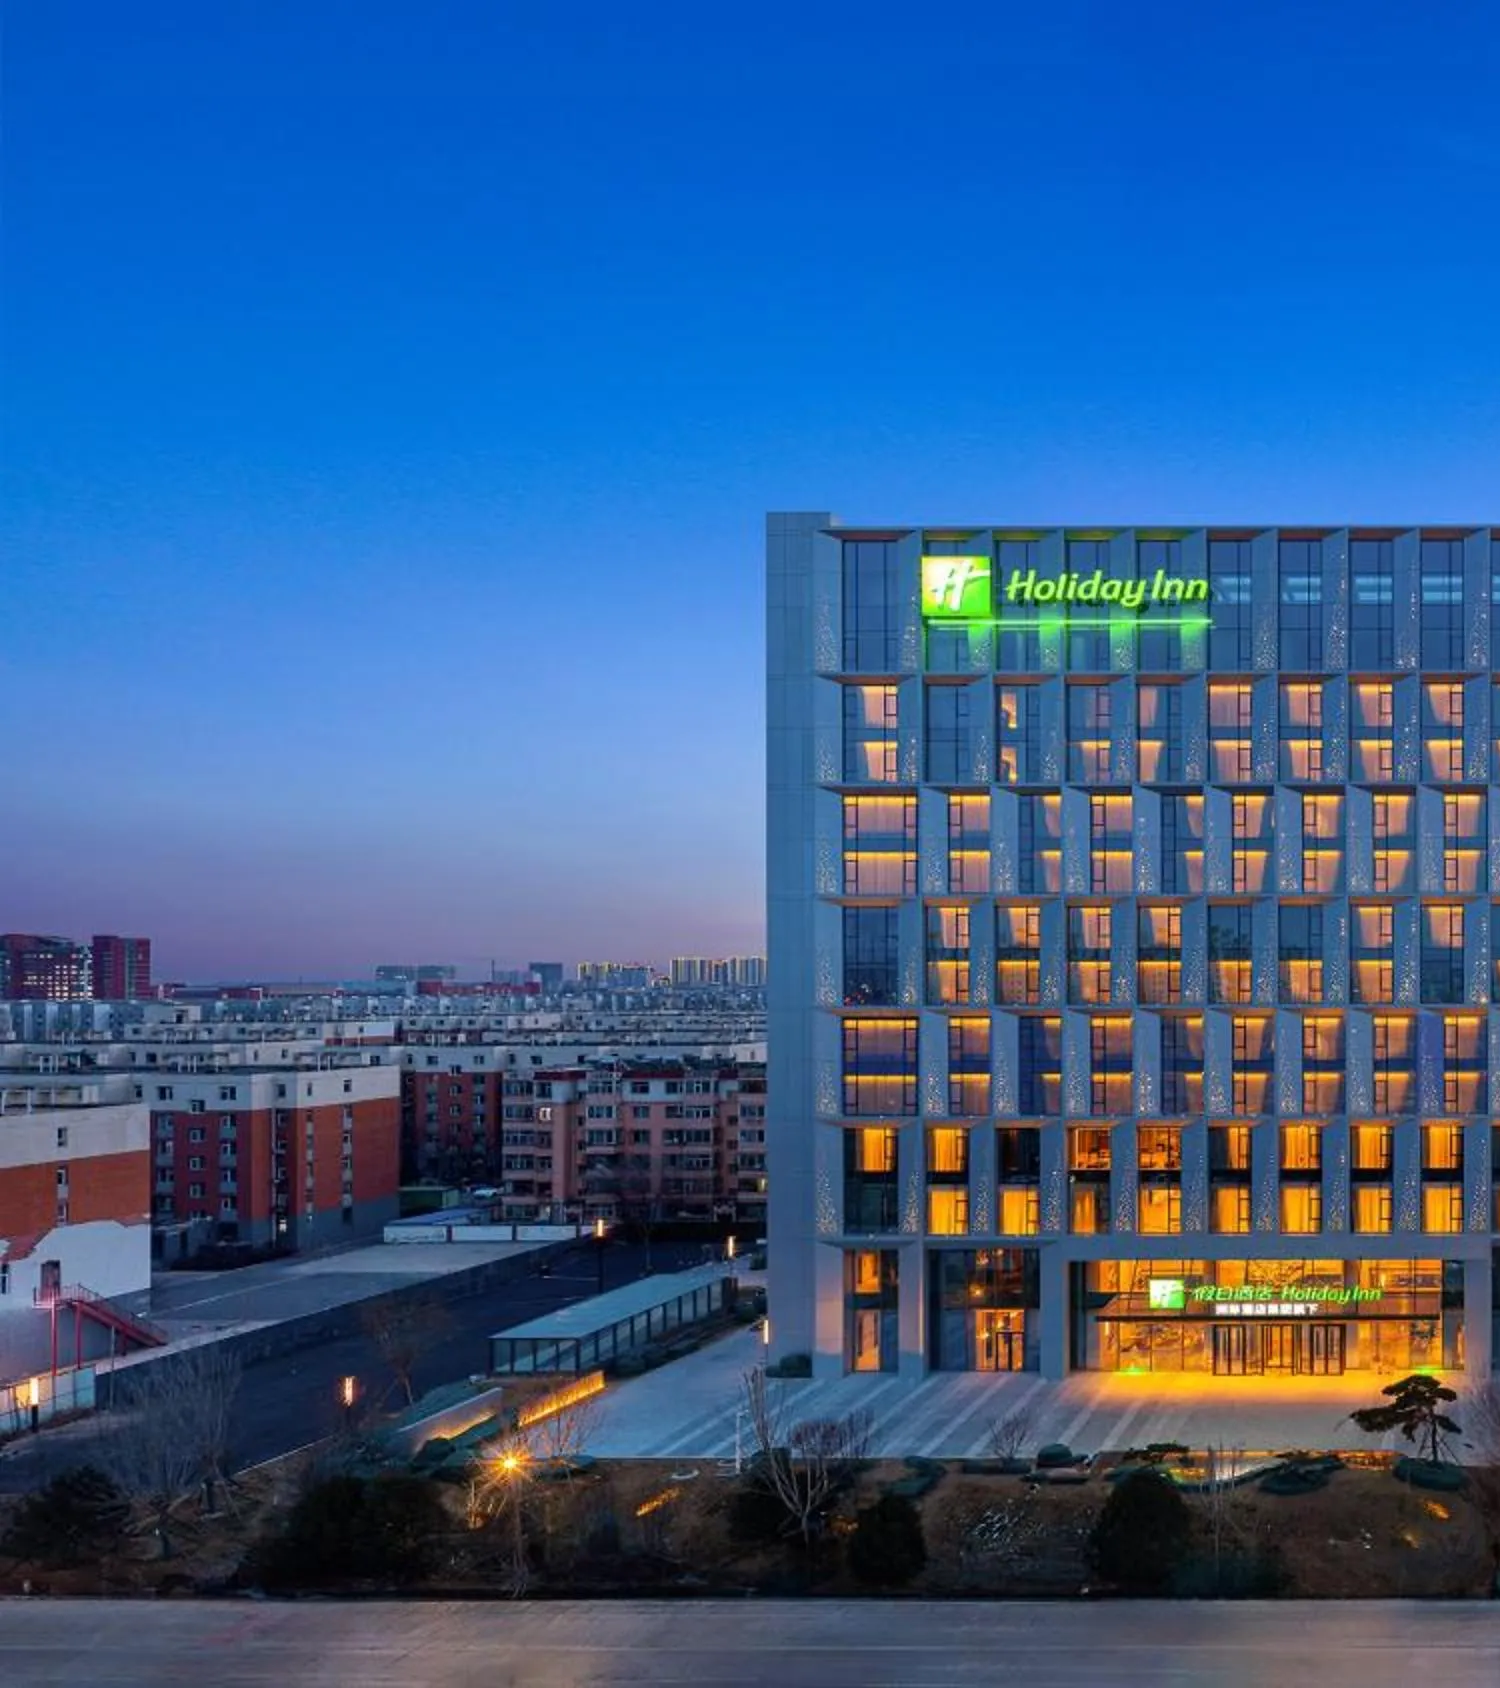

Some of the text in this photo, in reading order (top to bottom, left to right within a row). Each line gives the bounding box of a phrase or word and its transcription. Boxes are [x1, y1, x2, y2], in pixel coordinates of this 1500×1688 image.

[1005, 569, 1147, 608] Holiday
[1151, 569, 1209, 600] Inn
[1192, 1285, 1381, 1305] 假日酒店 Holiday Inn
